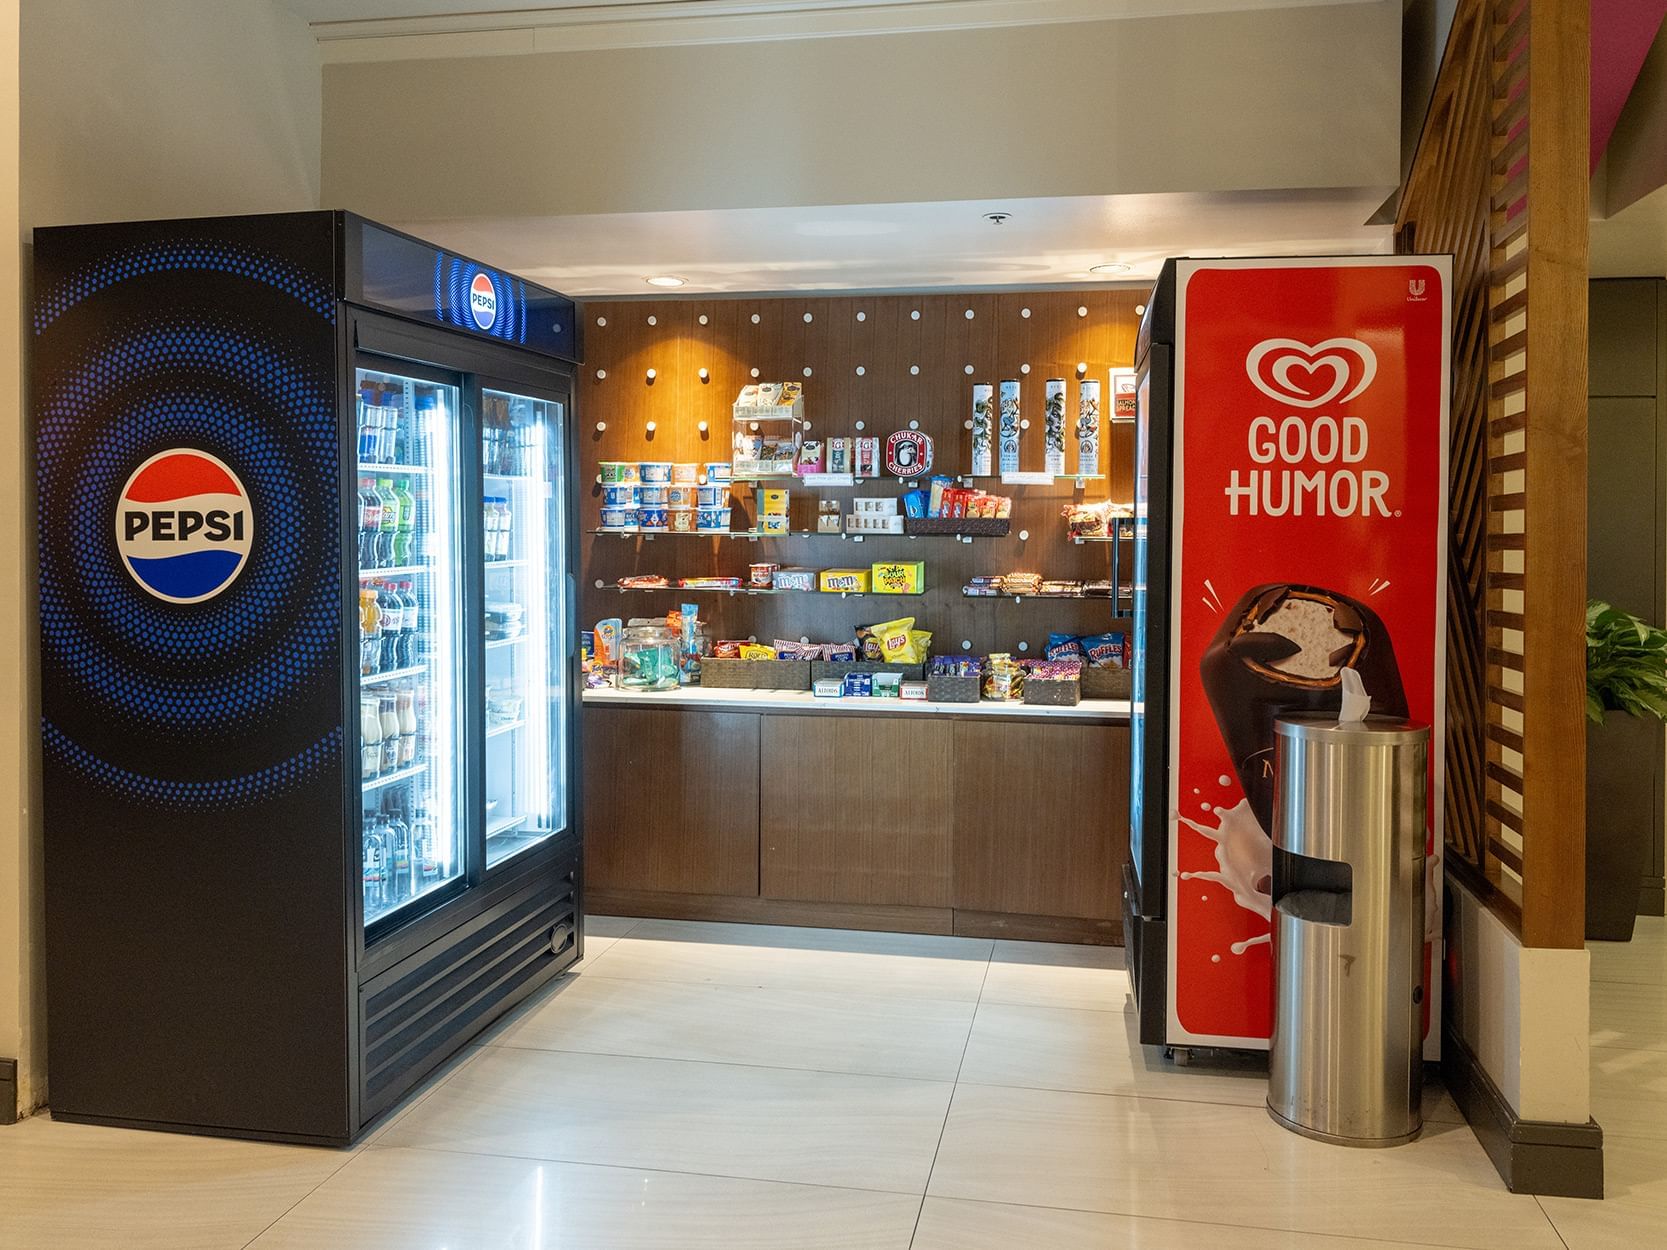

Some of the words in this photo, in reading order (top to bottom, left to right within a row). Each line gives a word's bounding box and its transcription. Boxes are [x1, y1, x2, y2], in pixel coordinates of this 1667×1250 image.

[472, 293, 495, 310] PEPSI
[890, 432, 924, 445] CHUKAR
[1248, 415, 1369, 464] GOOD
[888, 462, 923, 475] CHERRIES
[1224, 469, 1393, 518] HUMOR
[124, 509, 244, 542] PEPSI
[1089, 644, 1122, 659] RUFFLES
